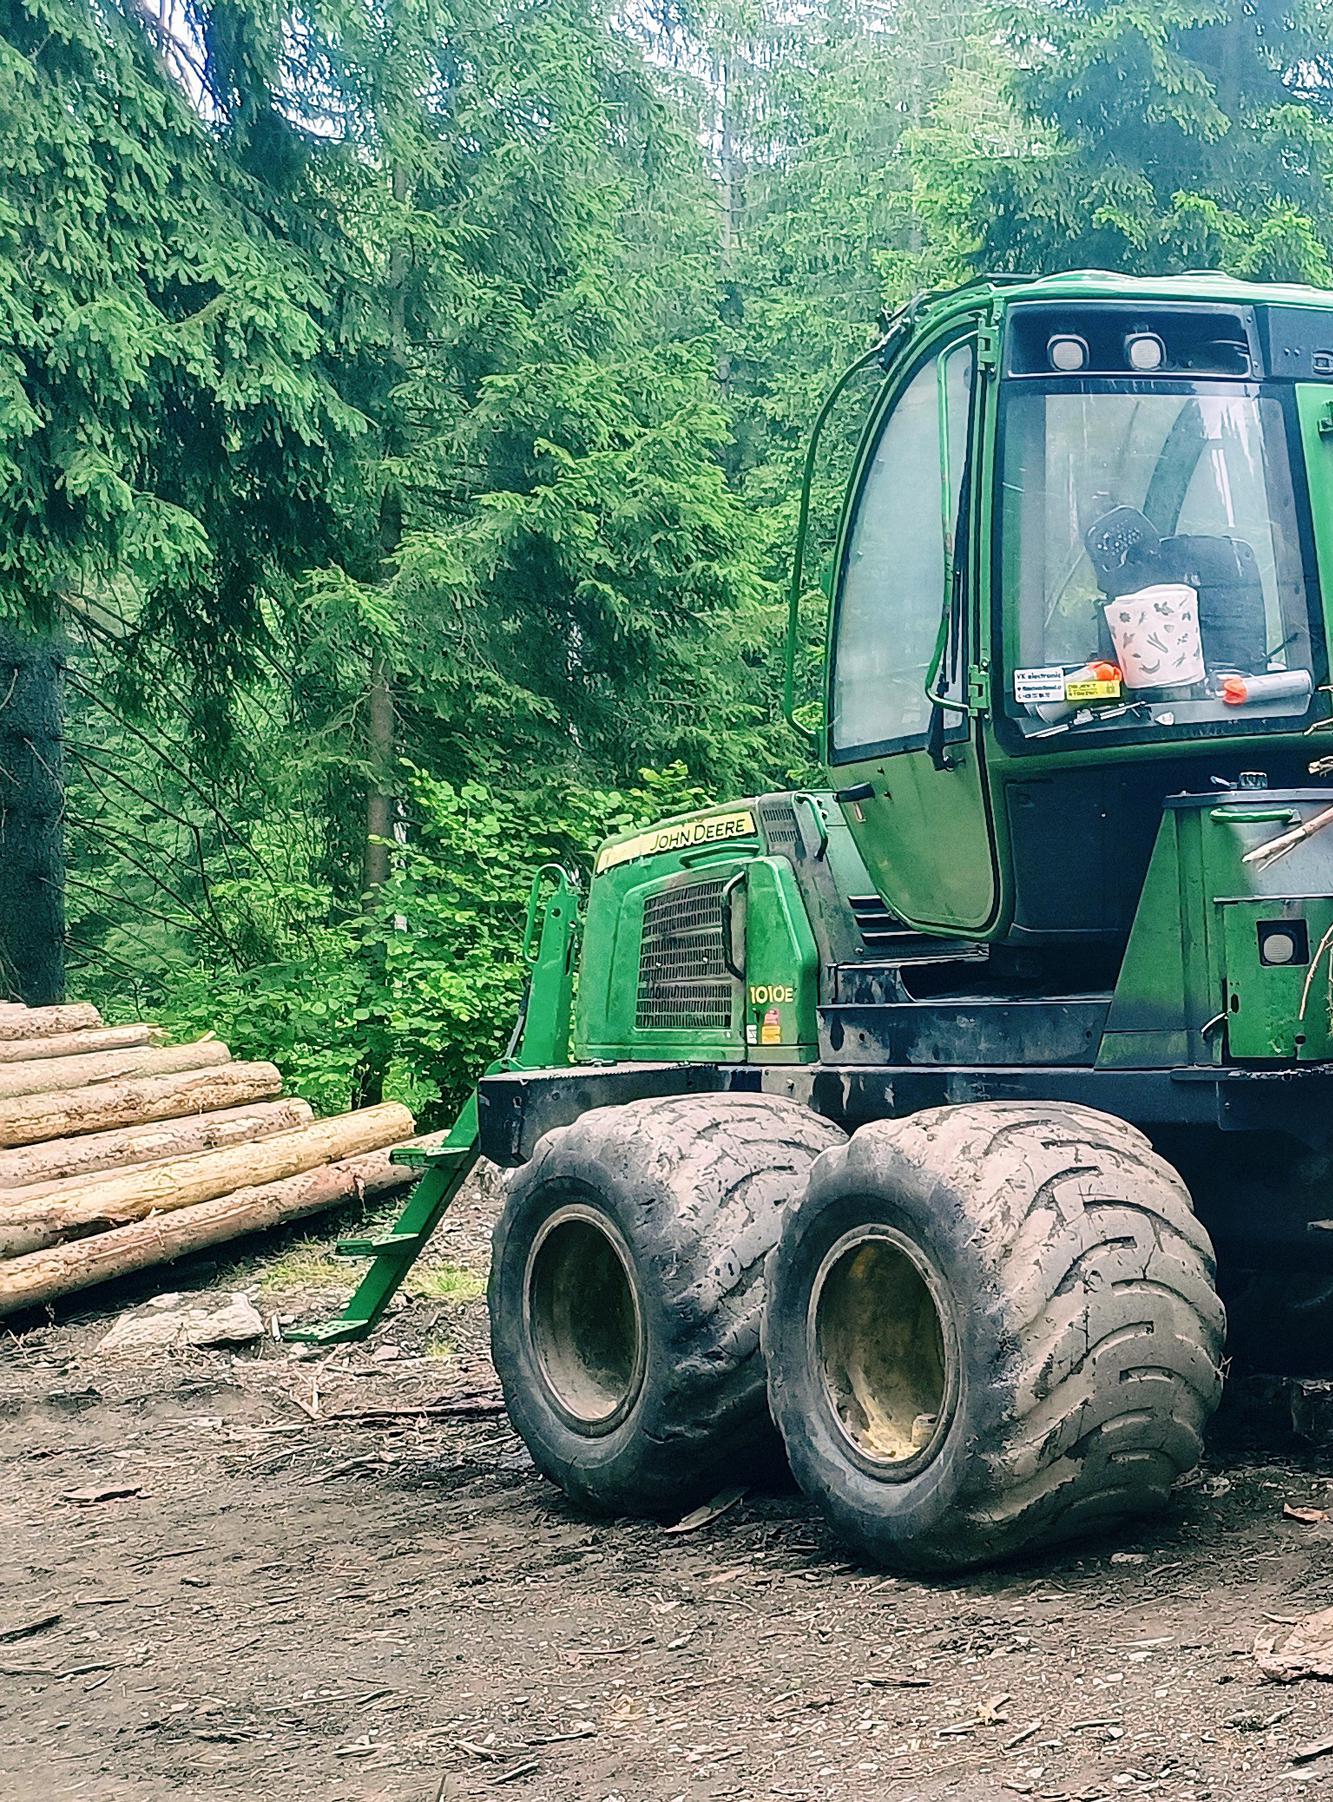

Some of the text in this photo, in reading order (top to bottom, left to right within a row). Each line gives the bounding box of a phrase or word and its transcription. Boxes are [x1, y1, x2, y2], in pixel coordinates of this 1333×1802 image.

[650, 818, 746, 851] JOHN DEERE
[750, 985, 794, 1004] 1010E
